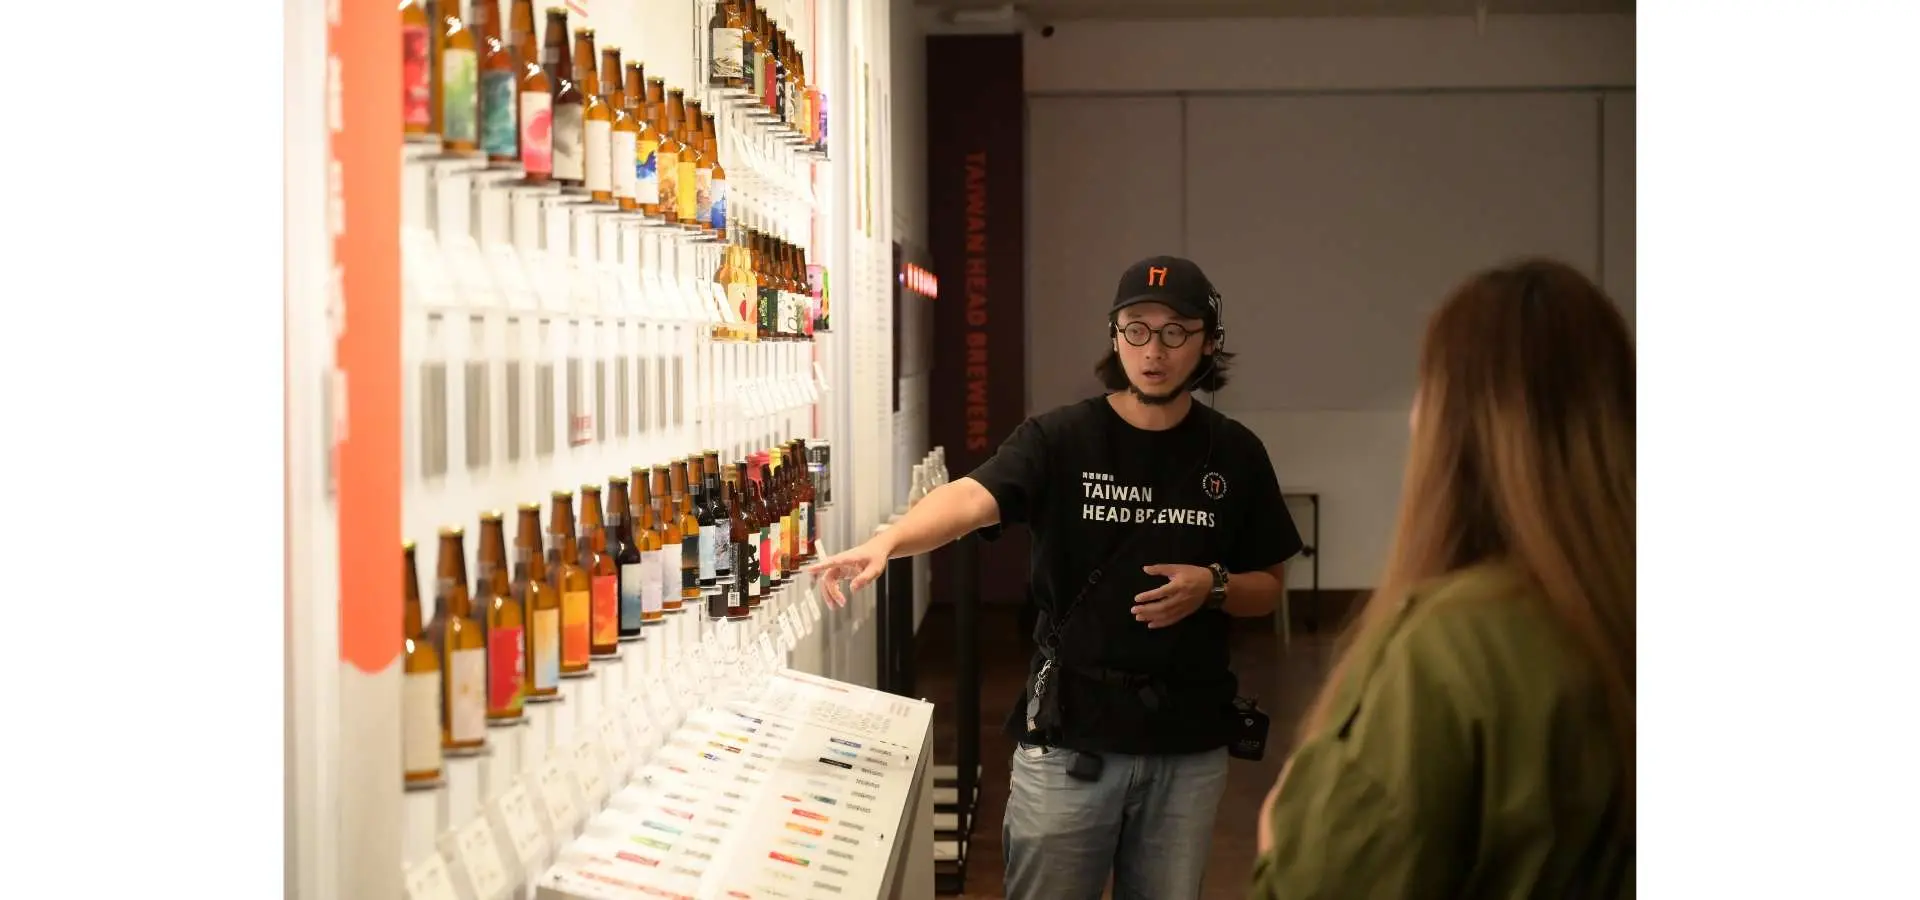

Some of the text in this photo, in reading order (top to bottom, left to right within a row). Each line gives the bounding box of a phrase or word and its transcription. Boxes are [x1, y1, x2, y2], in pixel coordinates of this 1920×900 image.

[966, 152, 988, 450] TAIWAN HEAD BREWERS
[1083, 482, 1153, 502] TAIWAN
[1083, 504, 1131, 523] HEAD
